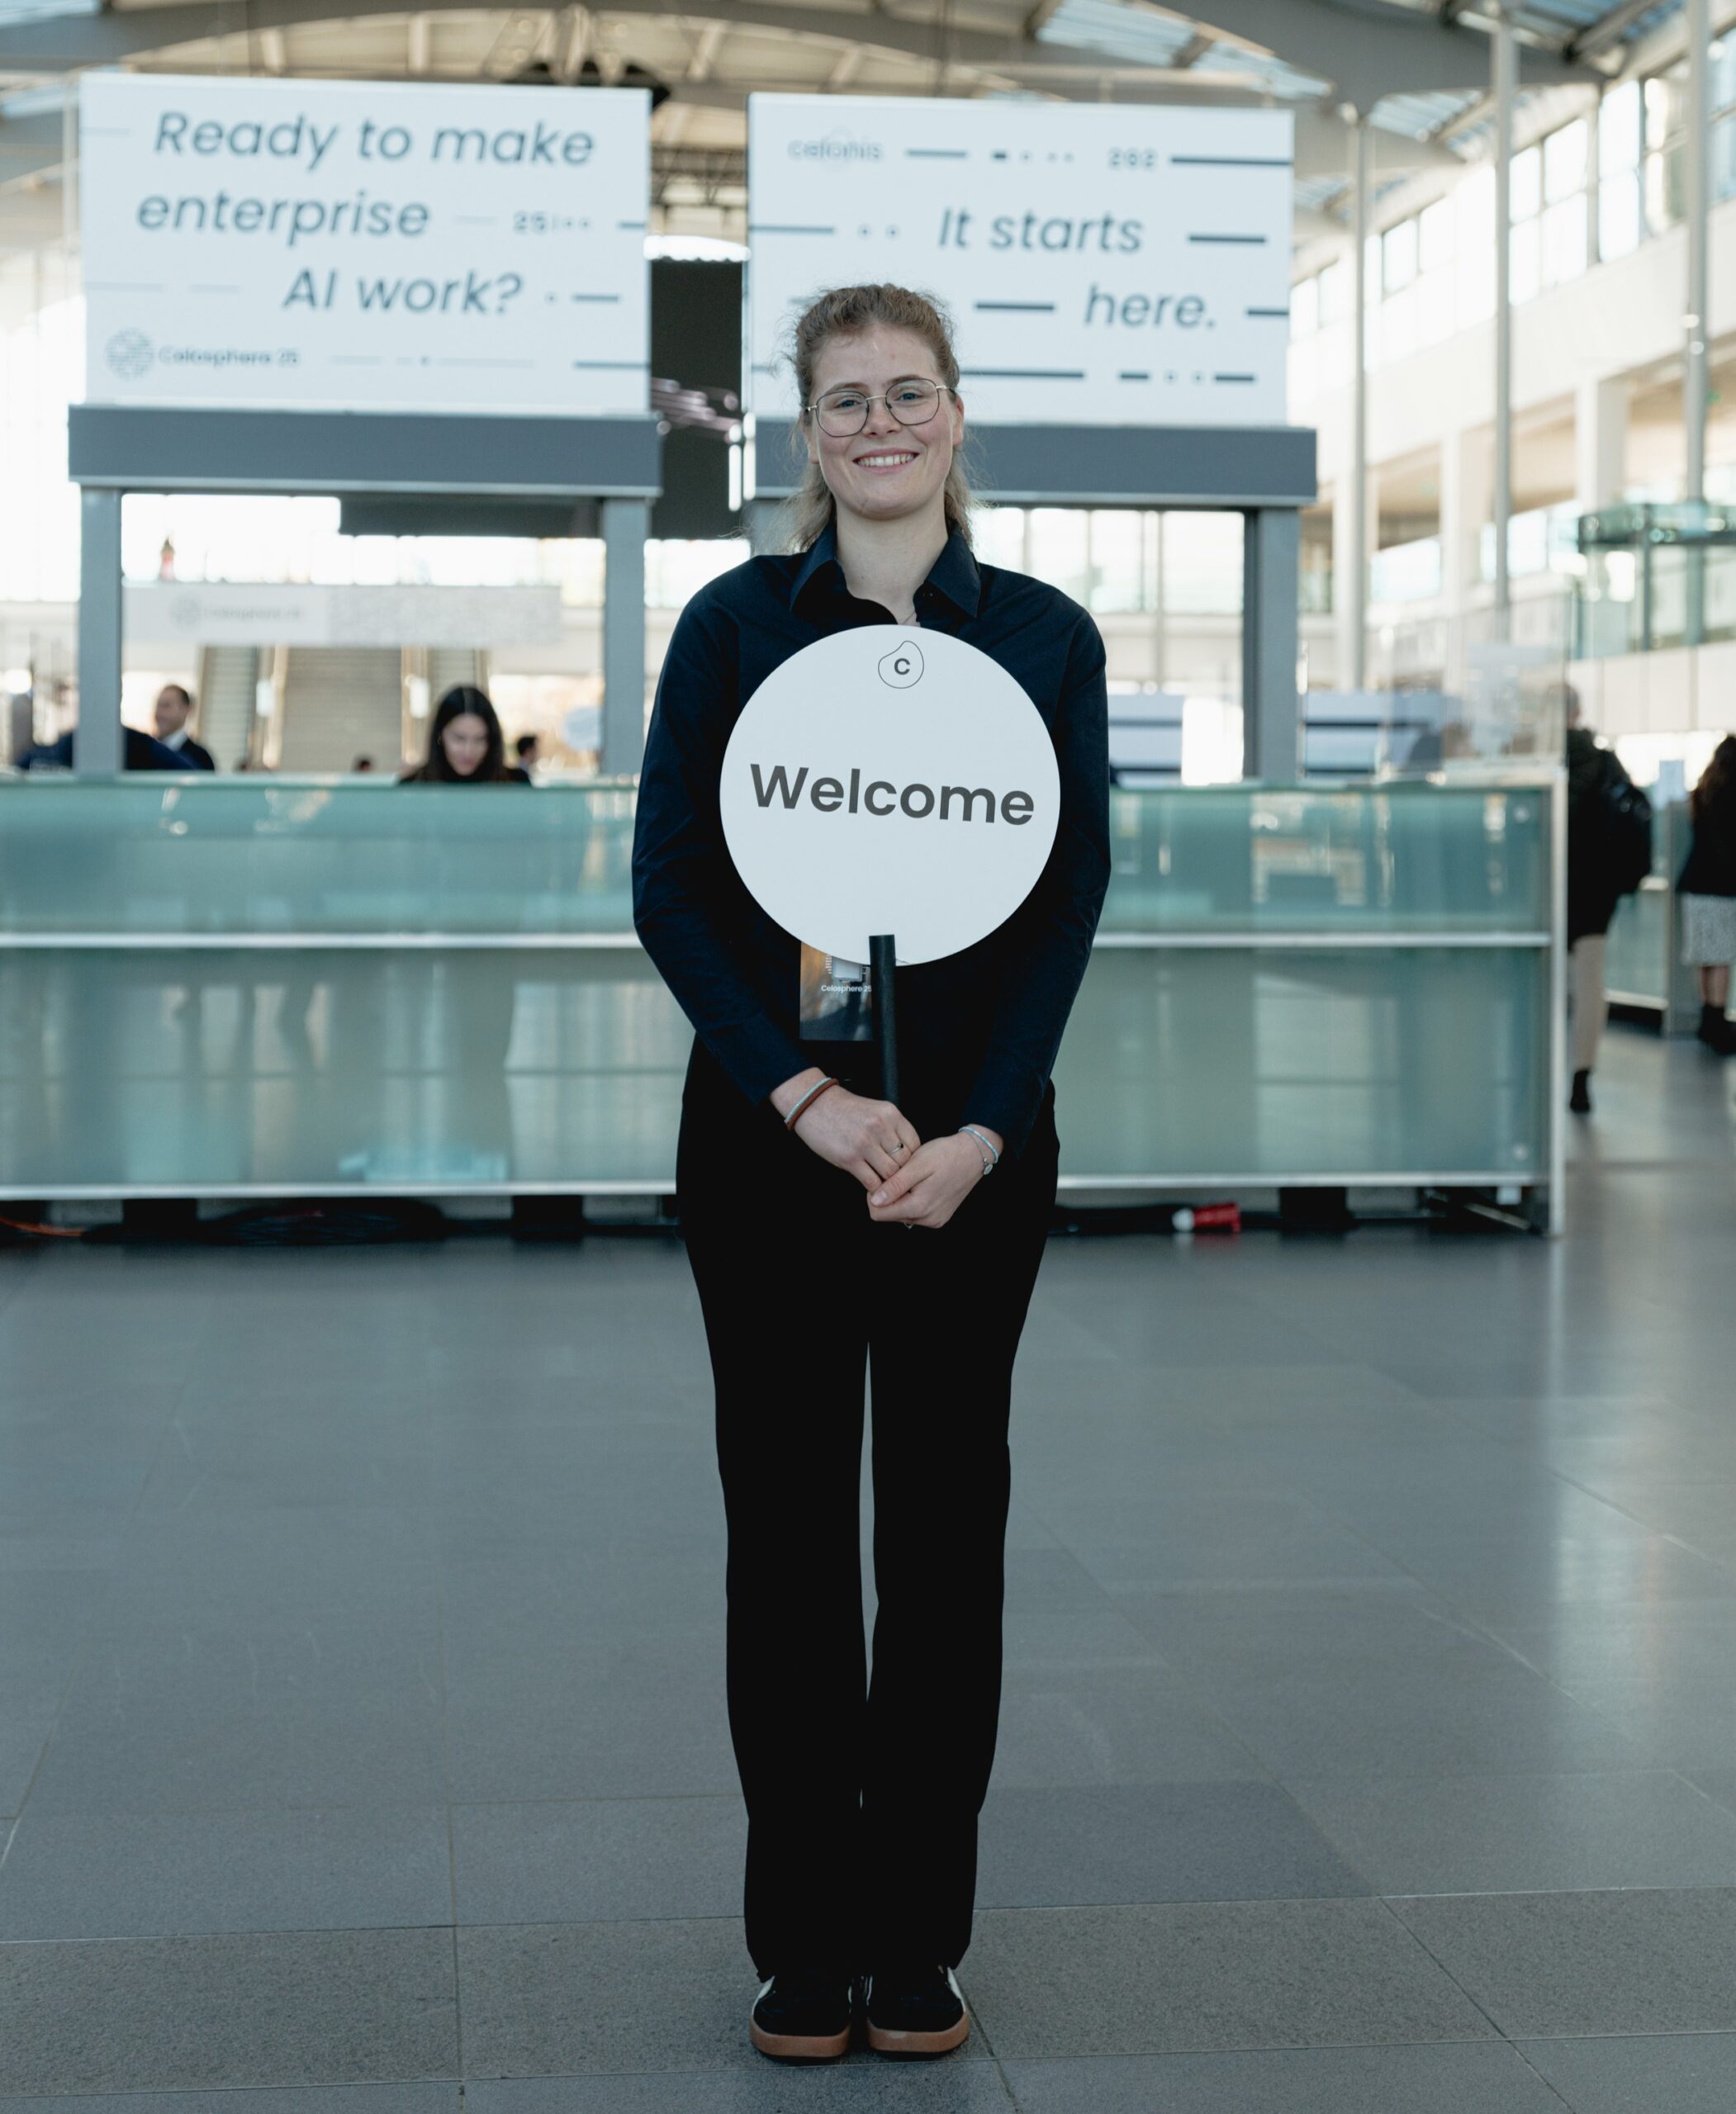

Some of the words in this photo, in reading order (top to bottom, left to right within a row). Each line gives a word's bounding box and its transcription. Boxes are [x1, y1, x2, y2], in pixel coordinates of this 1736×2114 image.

[154, 110, 339, 171] Ready
[357, 118, 412, 161] to
[430, 120, 595, 166] make
[787, 136, 883, 164] celonis
[135, 189, 431, 249] enterprise
[937, 206, 973, 249] It
[989, 210, 1145, 254] starts
[282, 267, 339, 310] AI
[356, 269, 524, 315] work?
[1082, 282, 1217, 329] here.
[159, 345, 271, 368] Celosphere
[749, 763, 1035, 826] Welcome
[821, 984, 863, 993] Celosphere
